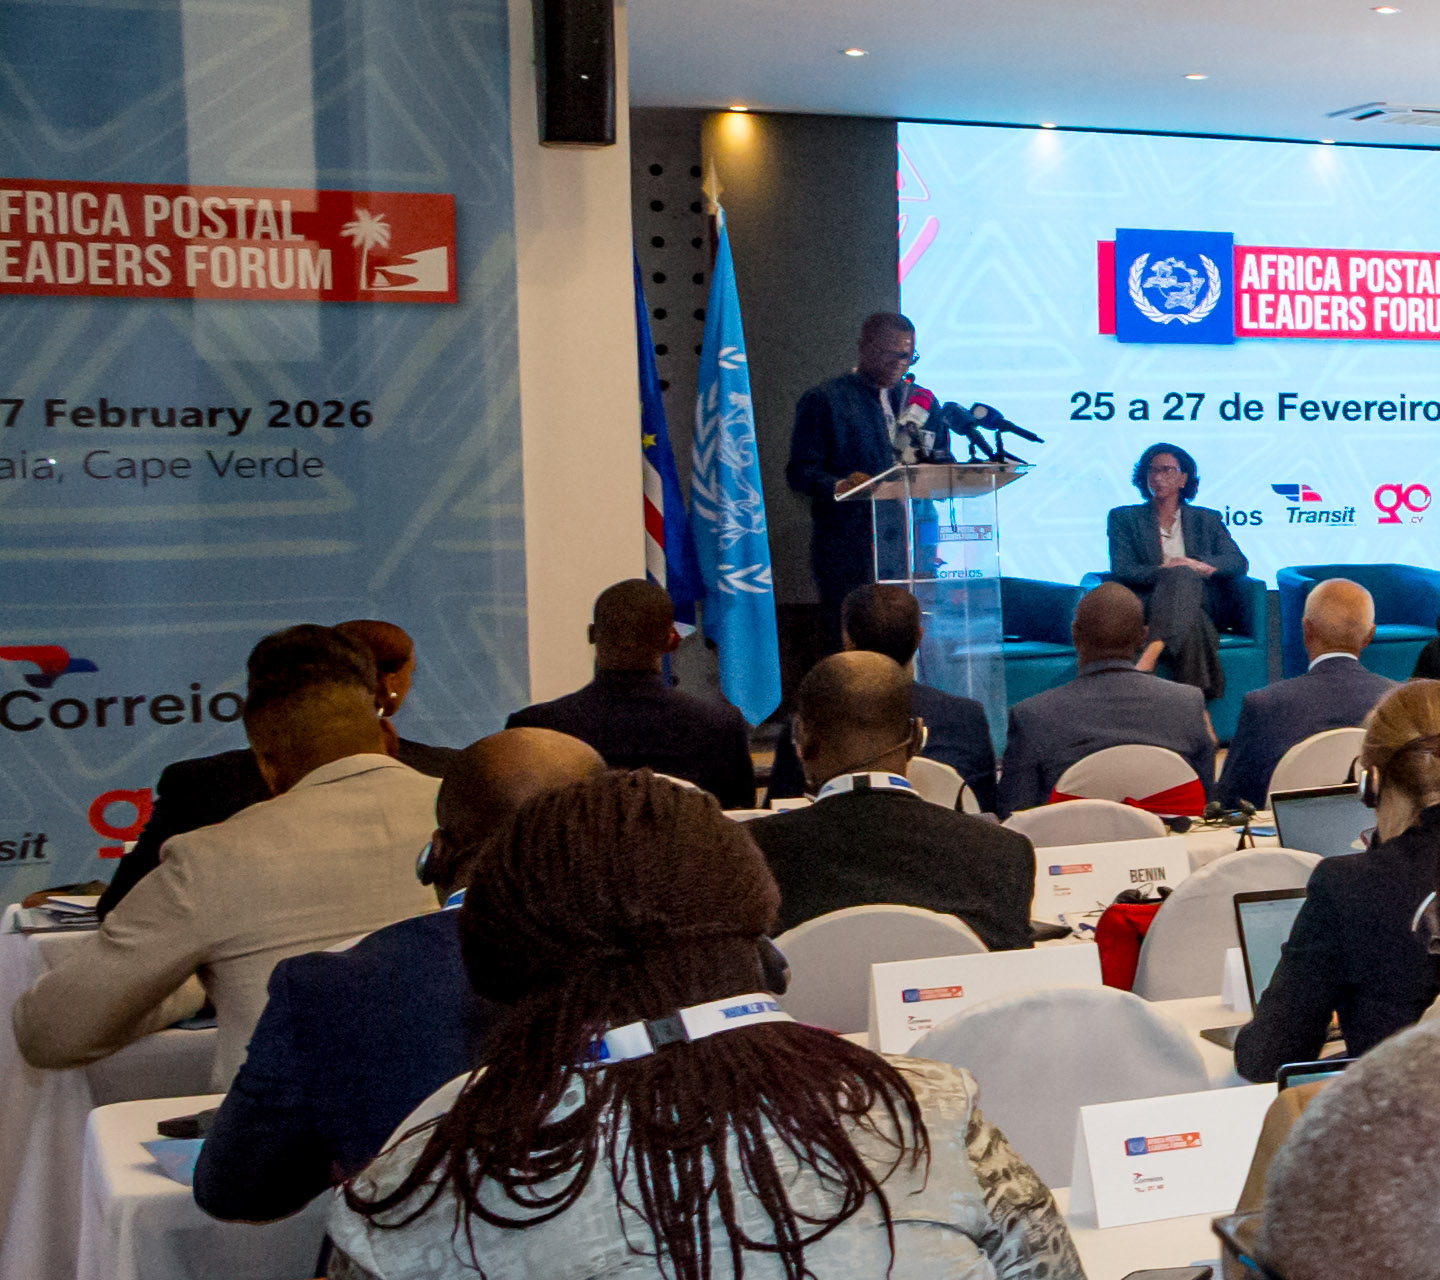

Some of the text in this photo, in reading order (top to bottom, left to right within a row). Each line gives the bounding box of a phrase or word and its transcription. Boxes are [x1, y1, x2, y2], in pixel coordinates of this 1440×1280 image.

[0, 189, 305, 242] FRICA POSTAL
[0, 239, 333, 290] EADERS FORUM
[1241, 254, 1342, 292] AFRICA
[1241, 294, 1367, 331] LEADERS
[45, 398, 252, 437] February
[268, 399, 373, 429] 2026
[1070, 392, 1116, 421] 25
[1128, 399, 1149, 421] a
[1163, 392, 1205, 421] 27
[1219, 392, 1264, 421] de
[0, 449, 324, 487] aia, Cape Verde
[1286, 506, 1356, 524] Transit
[1373, 483, 1432, 524] go
[0, 682, 245, 732] Correio
[1129, 867, 1166, 883] BENIN
